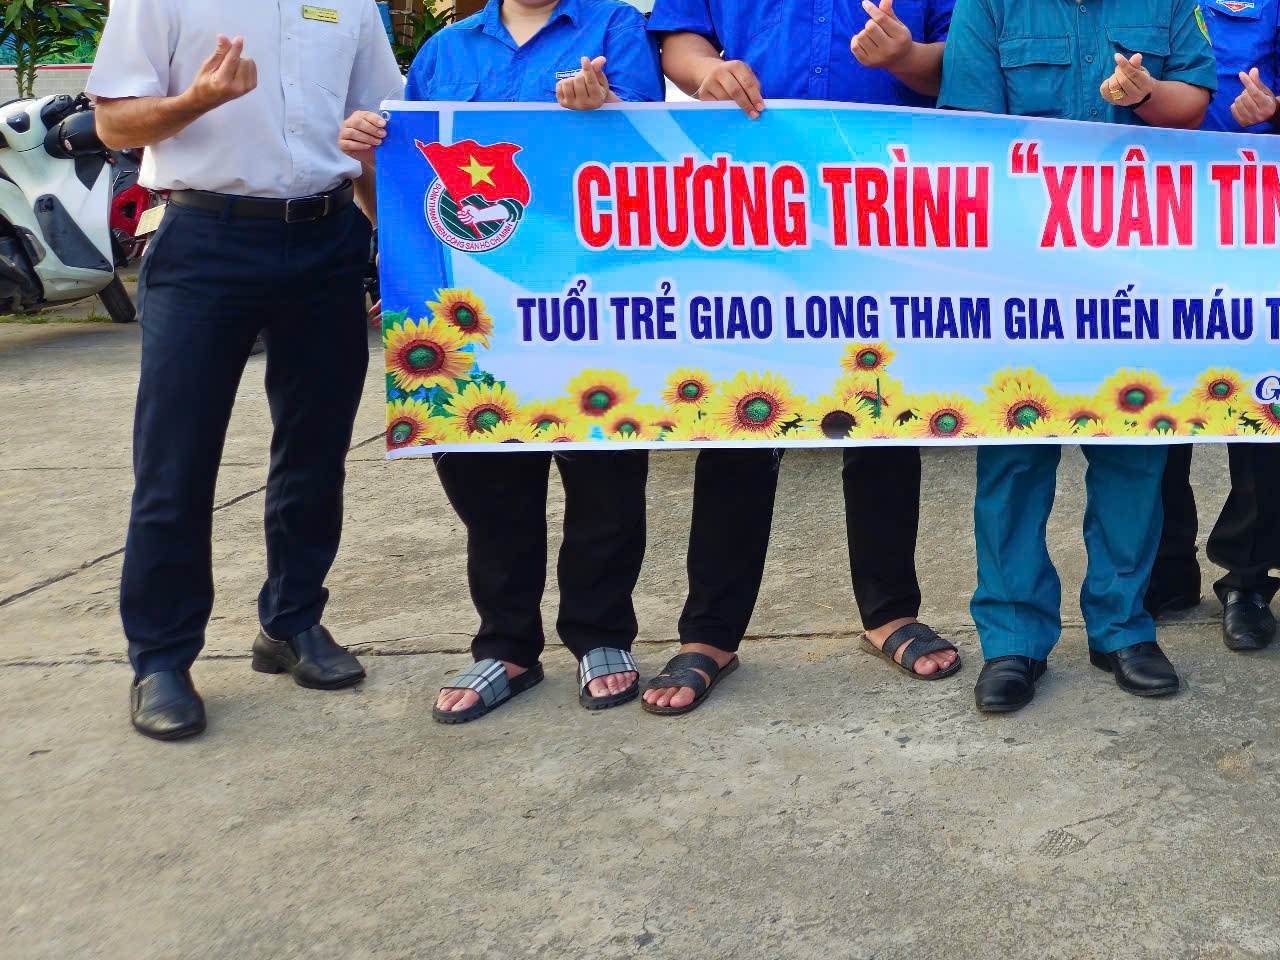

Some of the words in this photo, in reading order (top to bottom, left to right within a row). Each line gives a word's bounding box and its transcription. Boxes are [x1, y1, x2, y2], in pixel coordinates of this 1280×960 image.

[576, 155, 808, 249] CHƯƠNG
[822, 145, 990, 249] TRÌNH
[517, 278, 599, 342] TUỔI
[610, 280, 677, 340] TRẺ
[689, 295, 773, 340] GIAO
[785, 295, 879, 339] LONG
[890, 296, 992, 339] THAM
[1004, 297, 1065, 340] GIA
[1075, 283, 1160, 340] HIẾN
[1172, 288, 1254, 340] MÁU
